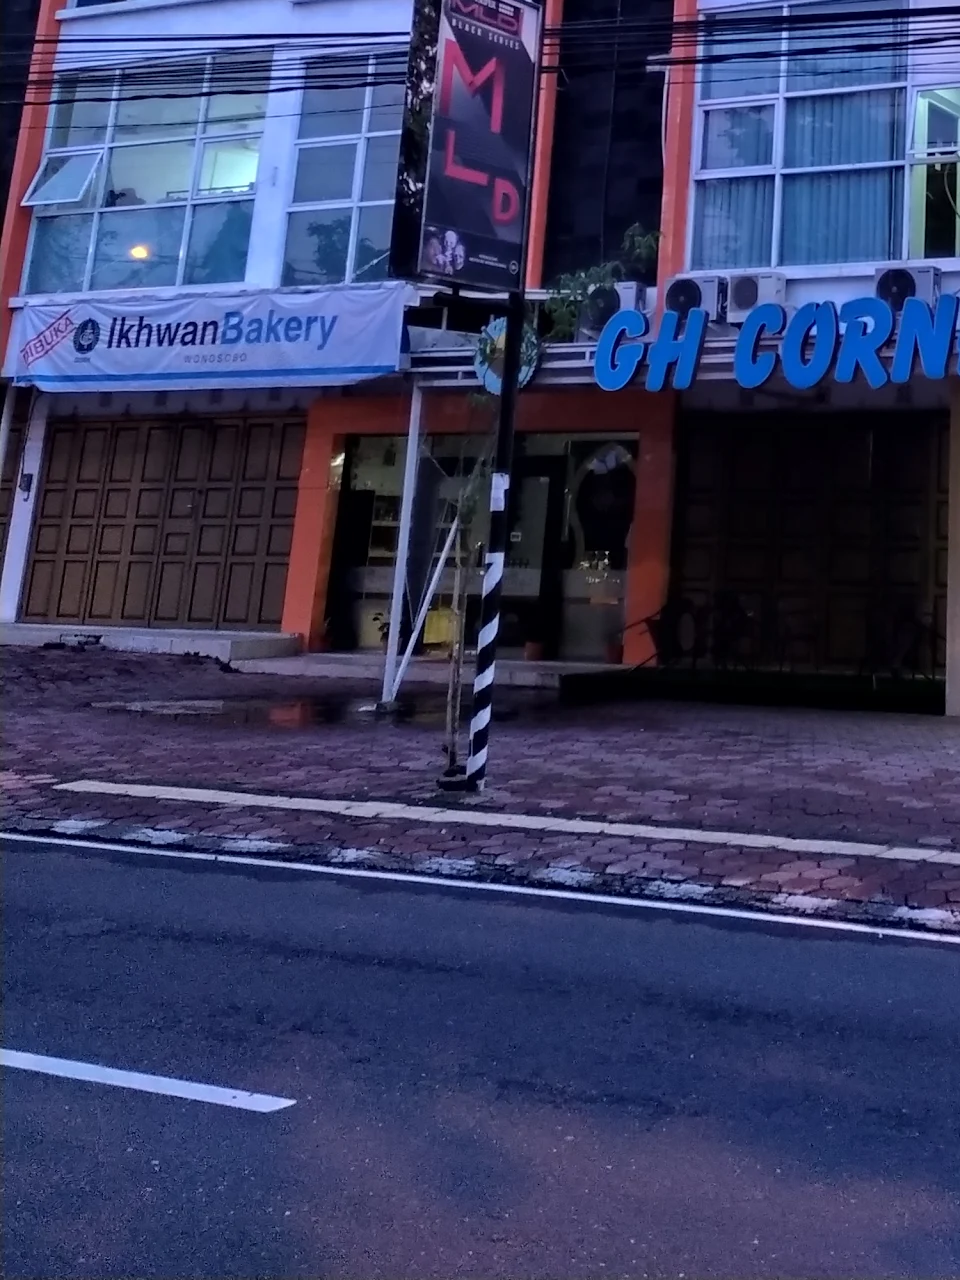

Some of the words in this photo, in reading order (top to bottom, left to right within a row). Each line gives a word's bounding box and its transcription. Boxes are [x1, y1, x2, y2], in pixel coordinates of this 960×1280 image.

[451, 18, 482, 36] BLACK
[488, 32, 520, 50] SERIES
[22, 316, 74, 364] DIBUKA
[184, 352, 247, 364] WONOSOBO
[594, 308, 709, 392] GH
